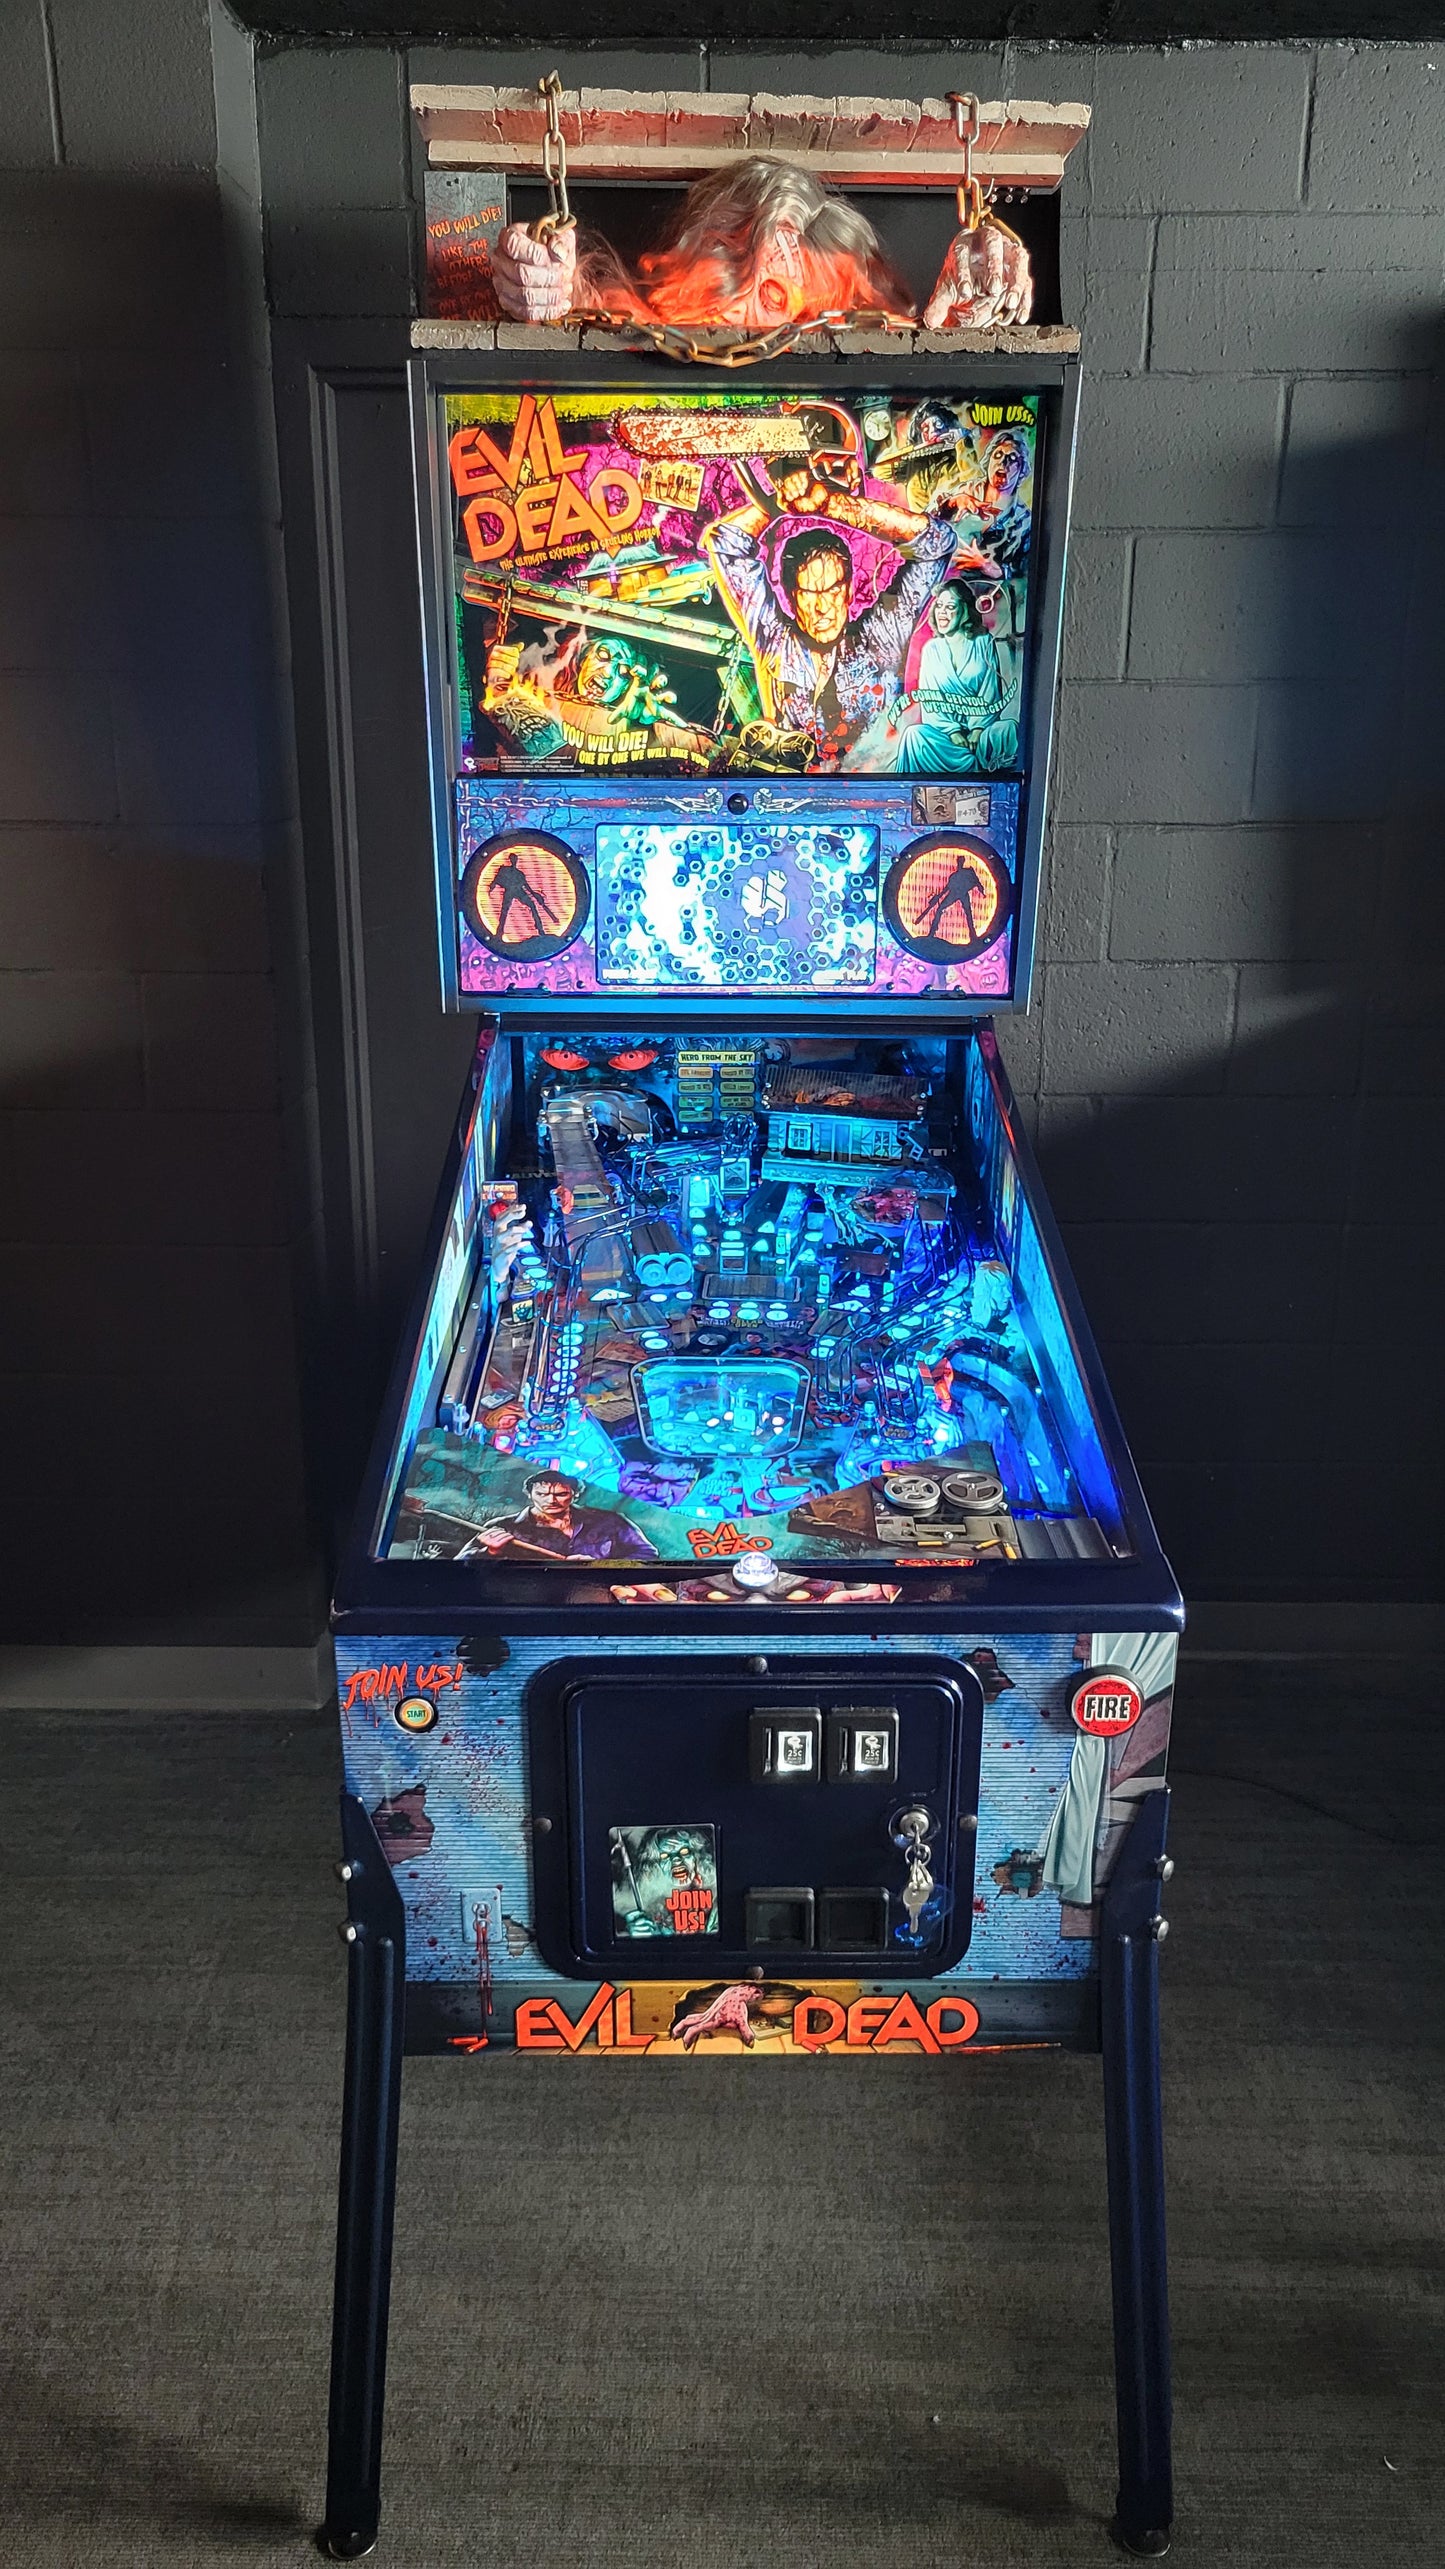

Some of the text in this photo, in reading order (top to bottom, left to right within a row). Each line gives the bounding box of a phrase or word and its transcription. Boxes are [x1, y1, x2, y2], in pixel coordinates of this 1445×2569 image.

[428, 206, 503, 239] YOU WILL DIE!
[441, 238, 489, 261] LIKE THE
[449, 252, 490, 271] OTHERS
[972, 403, 1004, 427] JOIN
[447, 393, 589, 497] EVIL
[462, 468, 644, 564] DEAD
[499, 526, 661, 572] THE ULTIMATE EXPERIENCE IN GRUELING HORROR
[888, 693, 912, 727] WE'RE
[911, 689, 944, 703] GONNA
[944, 692, 963, 705] GET
[923, 677, 1018, 716] WE'RE GONNA GET YOU
[562, 721, 649, 753] YOU WILL DIE!
[578, 750, 596, 765] ONE
[597, 752, 610, 765] BY
[611, 751, 629, 765] ONE
[630, 749, 646, 762] WE
[647, 747, 668, 759] WILL
[680, 1053, 753, 1062] HERO FROM THE SKY
[686, 1521, 750, 1545] EVIL
[692, 1536, 774, 1559] DEAD
[343, 1660, 464, 1711] JOIN US!
[406, 1709, 426, 1718] START
[1084, 1694, 1132, 1722] FIRE
[665, 1889, 713, 1911] JOIN
[674, 1910, 706, 1931] US!
[515, 1980, 981, 2054] EVIL DEAD
